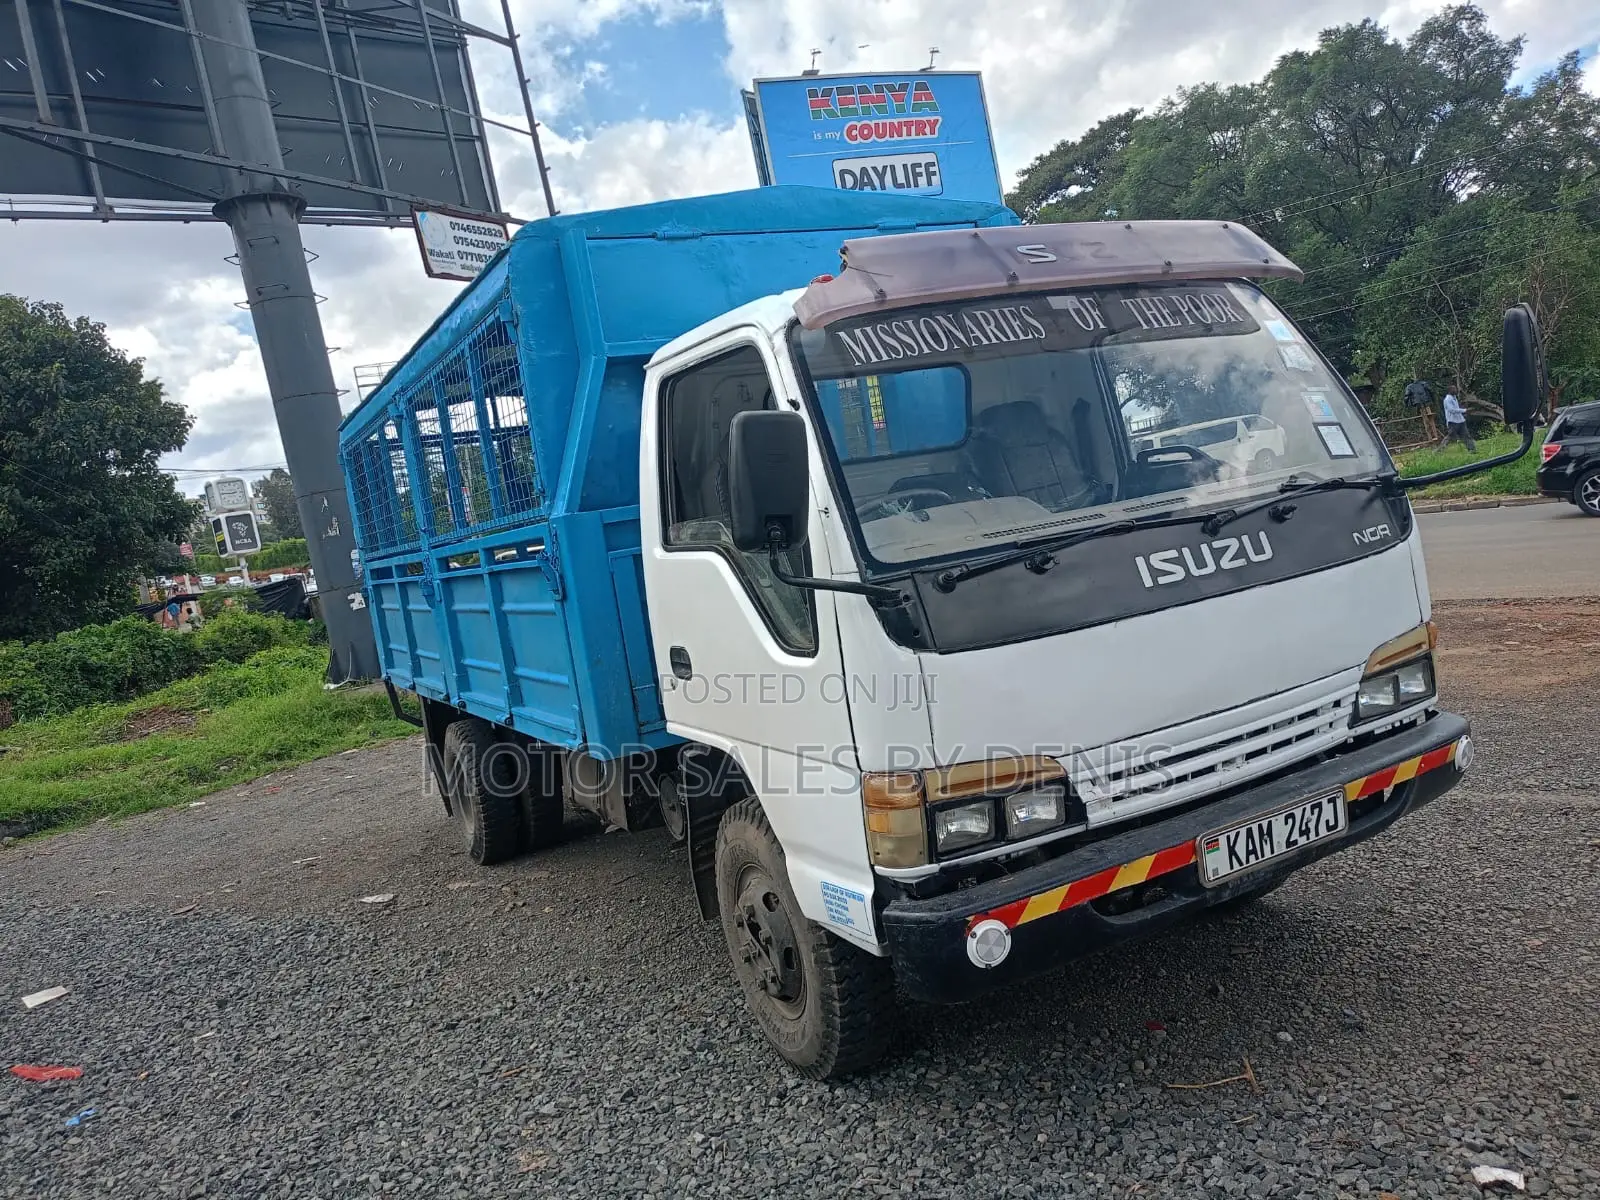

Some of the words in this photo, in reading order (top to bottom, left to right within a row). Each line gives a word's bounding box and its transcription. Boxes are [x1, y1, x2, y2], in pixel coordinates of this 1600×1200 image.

[806, 81, 940, 120] KENYA
[813, 130, 822, 140] is
[825, 130, 841, 141] my
[844, 118, 941, 143] COUNTRY
[839, 161, 937, 191] DAYLIFF
[450, 221, 503, 238] 0746552829
[836, 306, 1046, 366] MISSIONARIES
[1068, 297, 1108, 331] OF
[1121, 297, 1182, 330] THE
[1169, 293, 1244, 326] POOR
[1135, 530, 1274, 588] ISUZU
[1226, 820, 1275, 870] KAM
[1284, 796, 1339, 850] 247J
